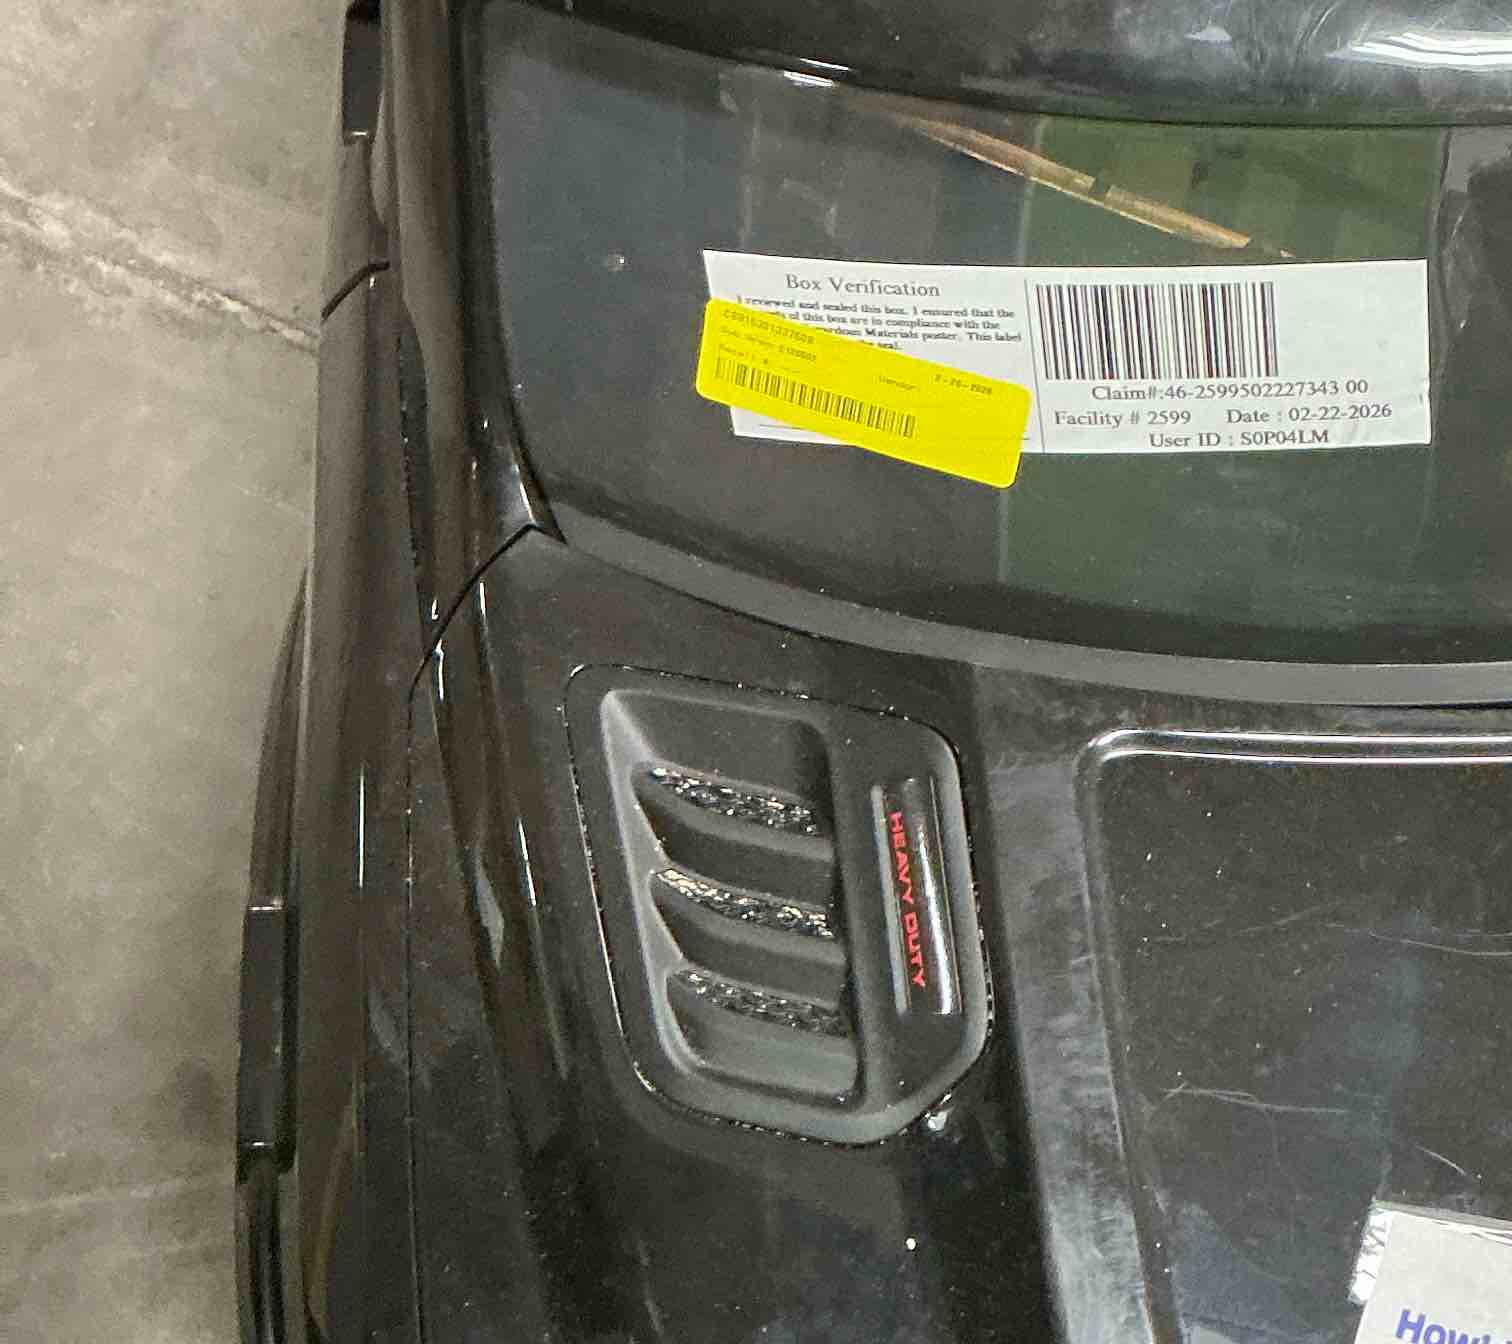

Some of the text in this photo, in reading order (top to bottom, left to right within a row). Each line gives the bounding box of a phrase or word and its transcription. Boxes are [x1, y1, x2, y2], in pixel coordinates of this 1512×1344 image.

[786, 273, 941, 298] Box Verification
[798, 299, 820, 310] and
[823, 300, 857, 312] sealed
[861, 302, 882, 314] this
[921, 306, 968, 318] ensured
[971, 307, 993, 318] that
[996, 308, 1015, 319] the
[787, 311, 800, 321] of
[803, 312, 825, 323] this
[827, 313, 848, 324] box
[849, 316, 869, 325] are
[871, 316, 883, 326] in
[885, 317, 952, 330] compliance
[954, 318, 979, 329] with
[981, 319, 1001, 329] the
[865, 327, 919, 341] Materials
[966, 331, 991, 342] This
[995, 332, 1023, 342] label
[1345, 378, 1369, 395] 00
[1055, 409, 1124, 429] Facility
[1130, 410, 1141, 426] #
[1147, 409, 1192, 426] 2599
[1226, 407, 1270, 425] Date
[1288, 403, 1393, 424] 02-22-2026
[1149, 432, 1192, 448] User
[1199, 432, 1222, 448] ID
[889, 811, 926, 989] HEAVY DUTY
